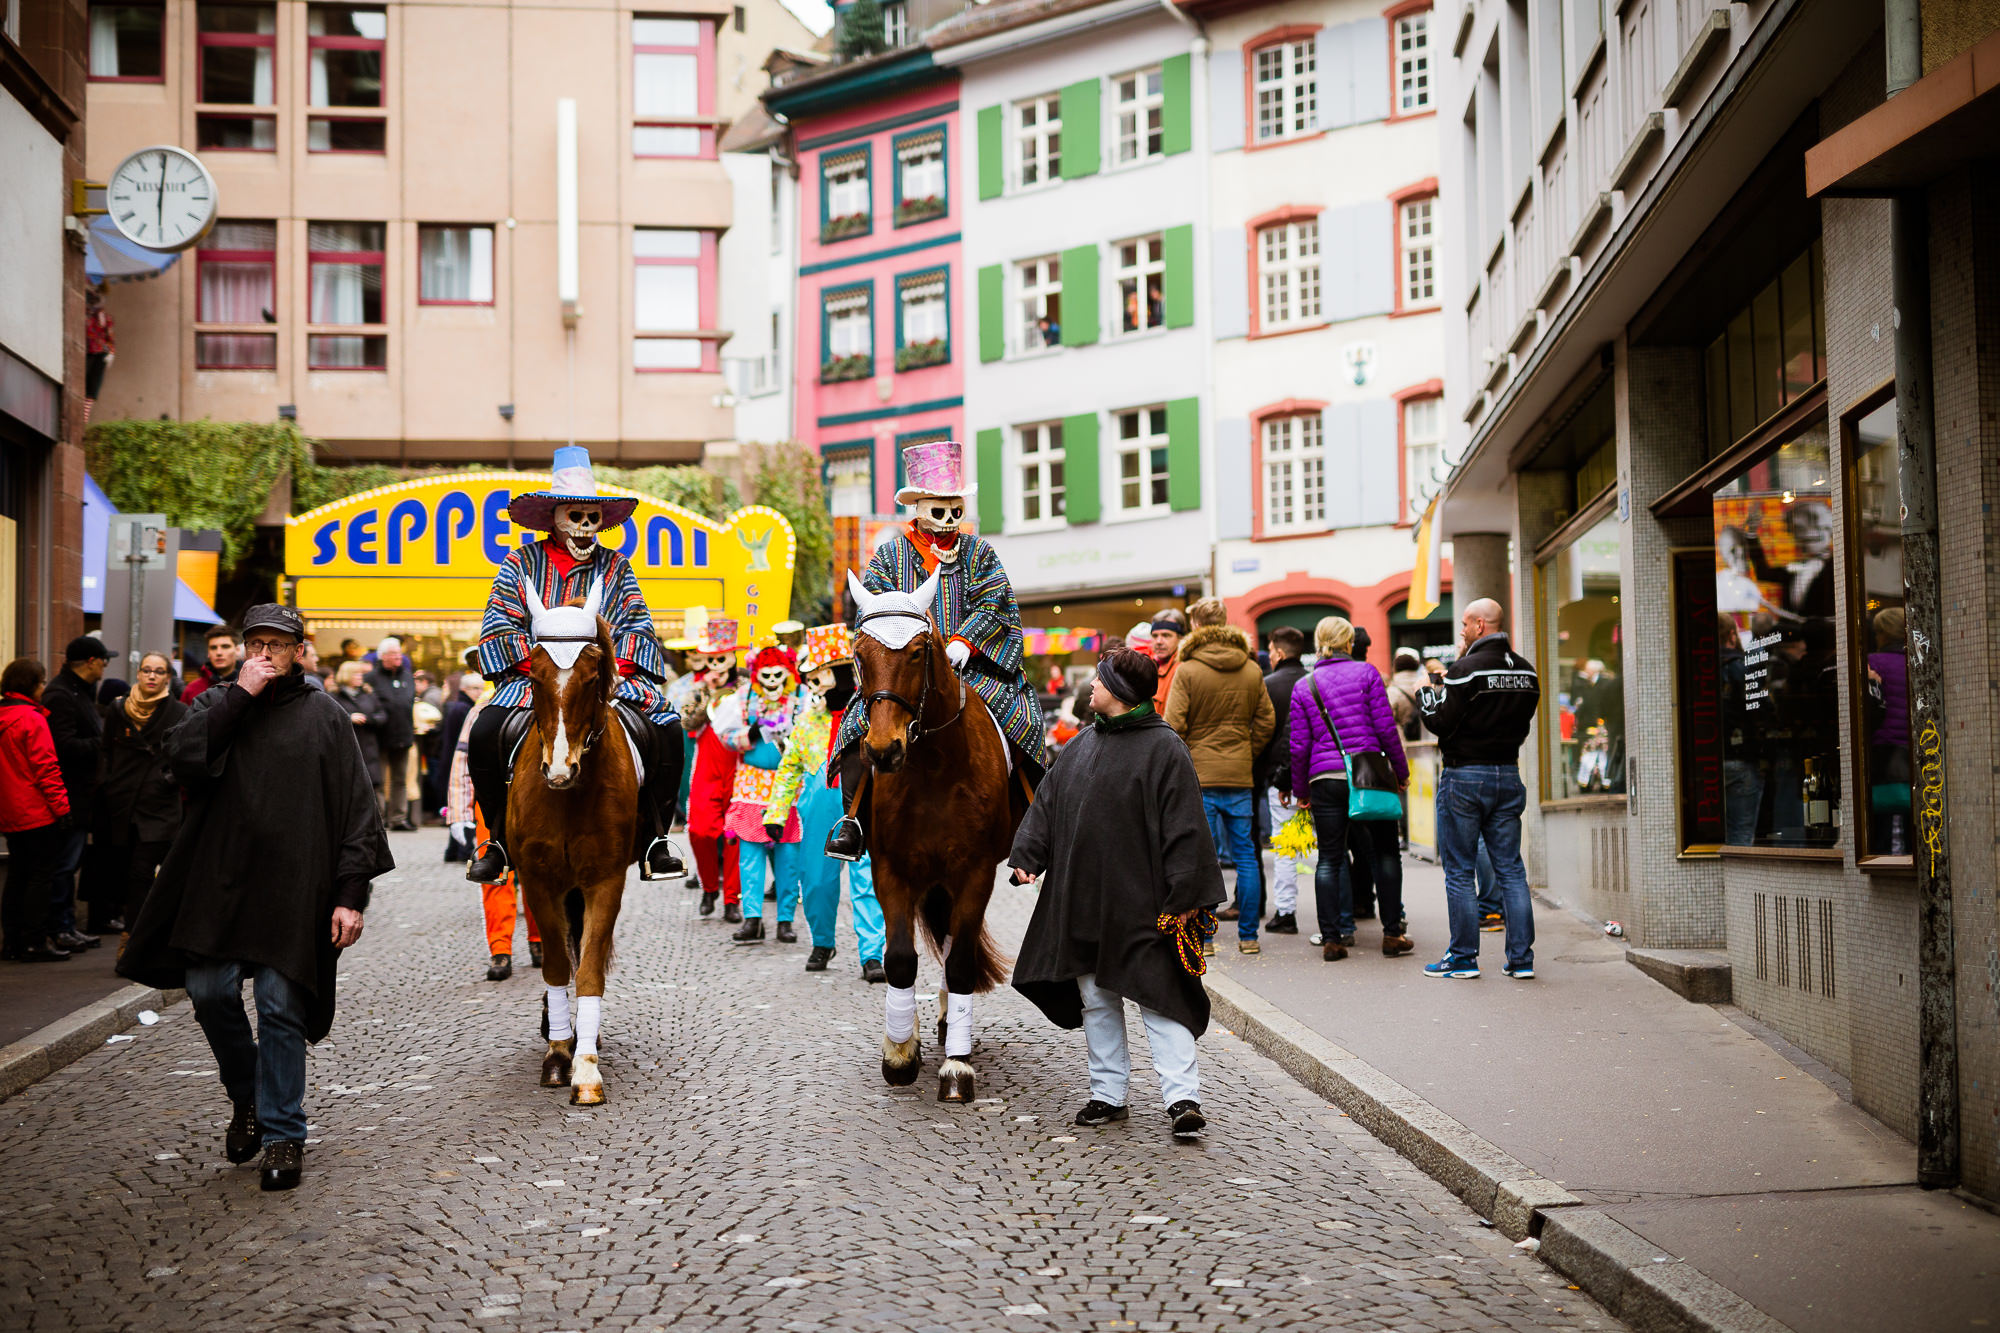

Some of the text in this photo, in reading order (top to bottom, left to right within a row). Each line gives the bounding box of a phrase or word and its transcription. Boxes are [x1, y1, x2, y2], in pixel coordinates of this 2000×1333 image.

[312, 489, 708, 566] SEPPEONI
[1488, 675, 1534, 689] RICHA
[1693, 635, 1719, 746] Ullrich
[1695, 754, 1720, 824] Paul
